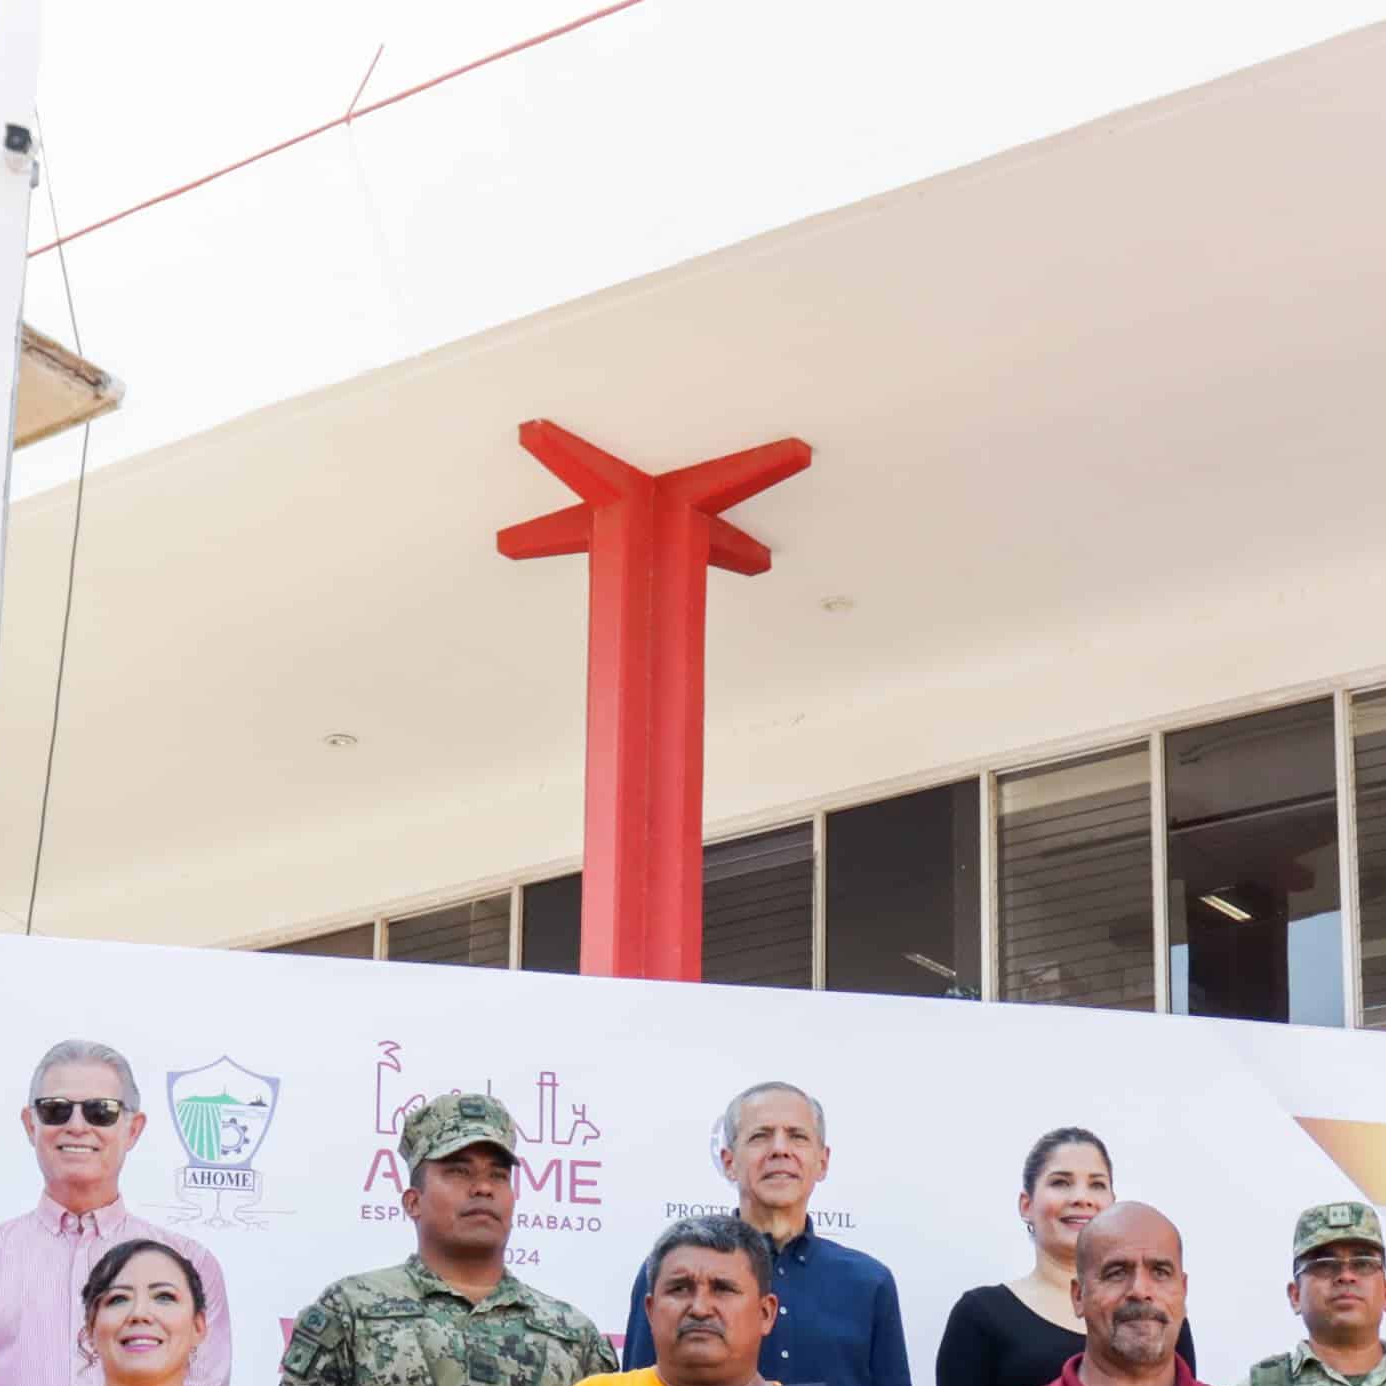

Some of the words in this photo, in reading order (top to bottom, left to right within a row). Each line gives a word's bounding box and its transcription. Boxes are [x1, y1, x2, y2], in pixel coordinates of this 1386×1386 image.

[188, 1171, 253, 1188] AHOME
[363, 1148, 602, 1205] AME
[511, 1214, 602, 1232] RABAJO
